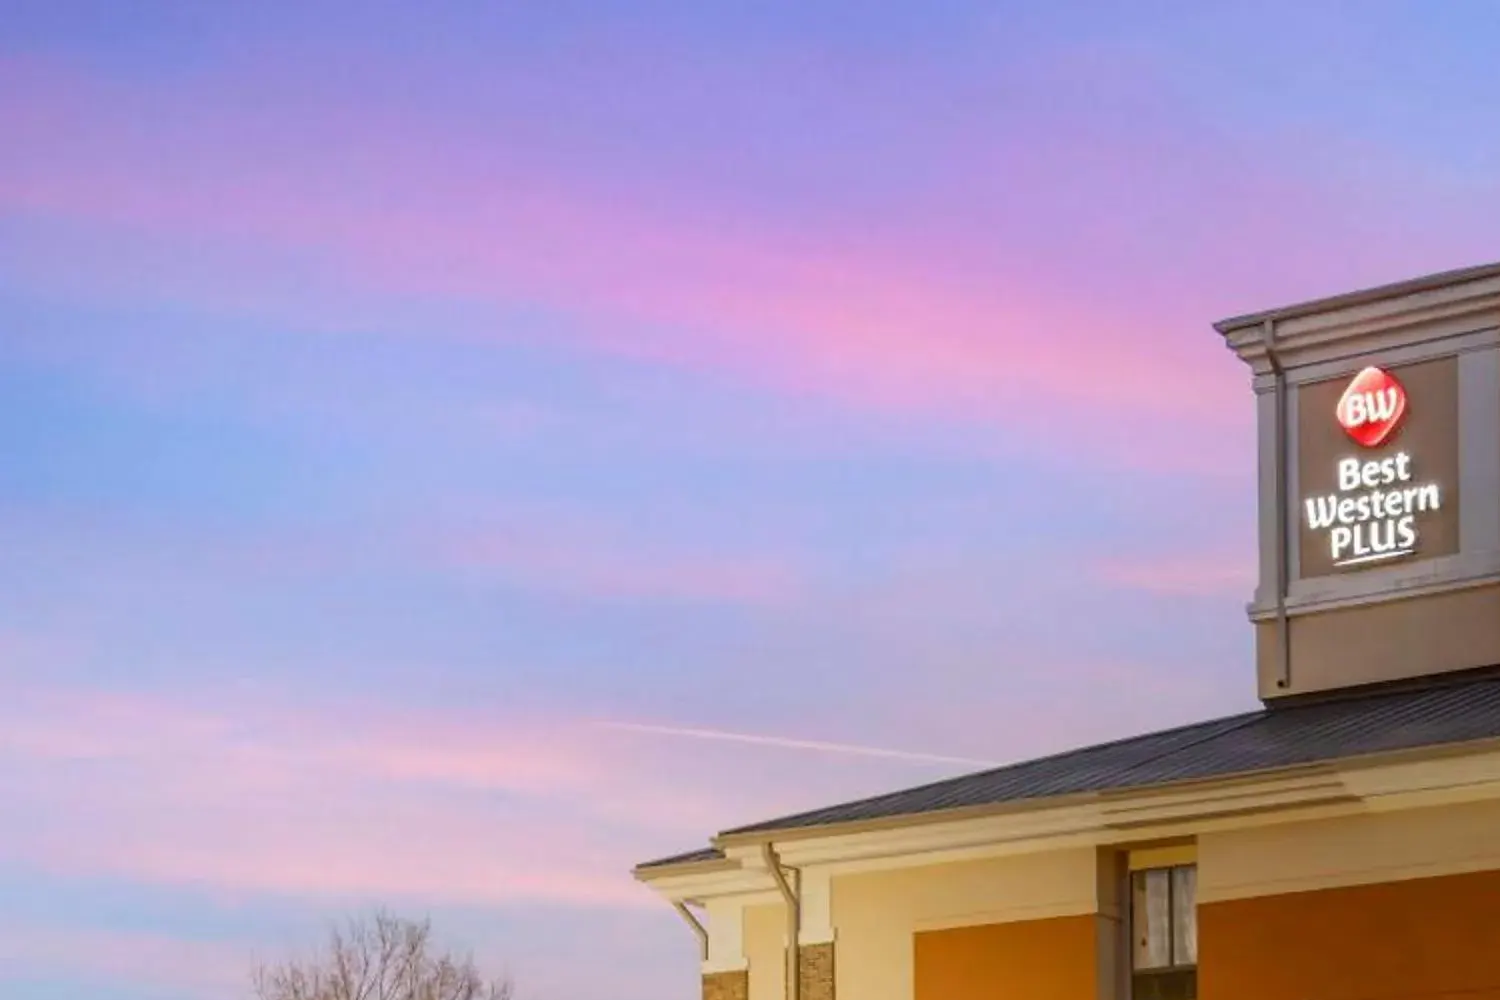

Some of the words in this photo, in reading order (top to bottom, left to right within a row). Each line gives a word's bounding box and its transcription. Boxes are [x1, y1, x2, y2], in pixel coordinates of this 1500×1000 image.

[1346, 389, 1396, 427] BW
[1339, 452, 1411, 490] Best
[1306, 484, 1439, 528] Western
[1331, 516, 1416, 559] PLUS
